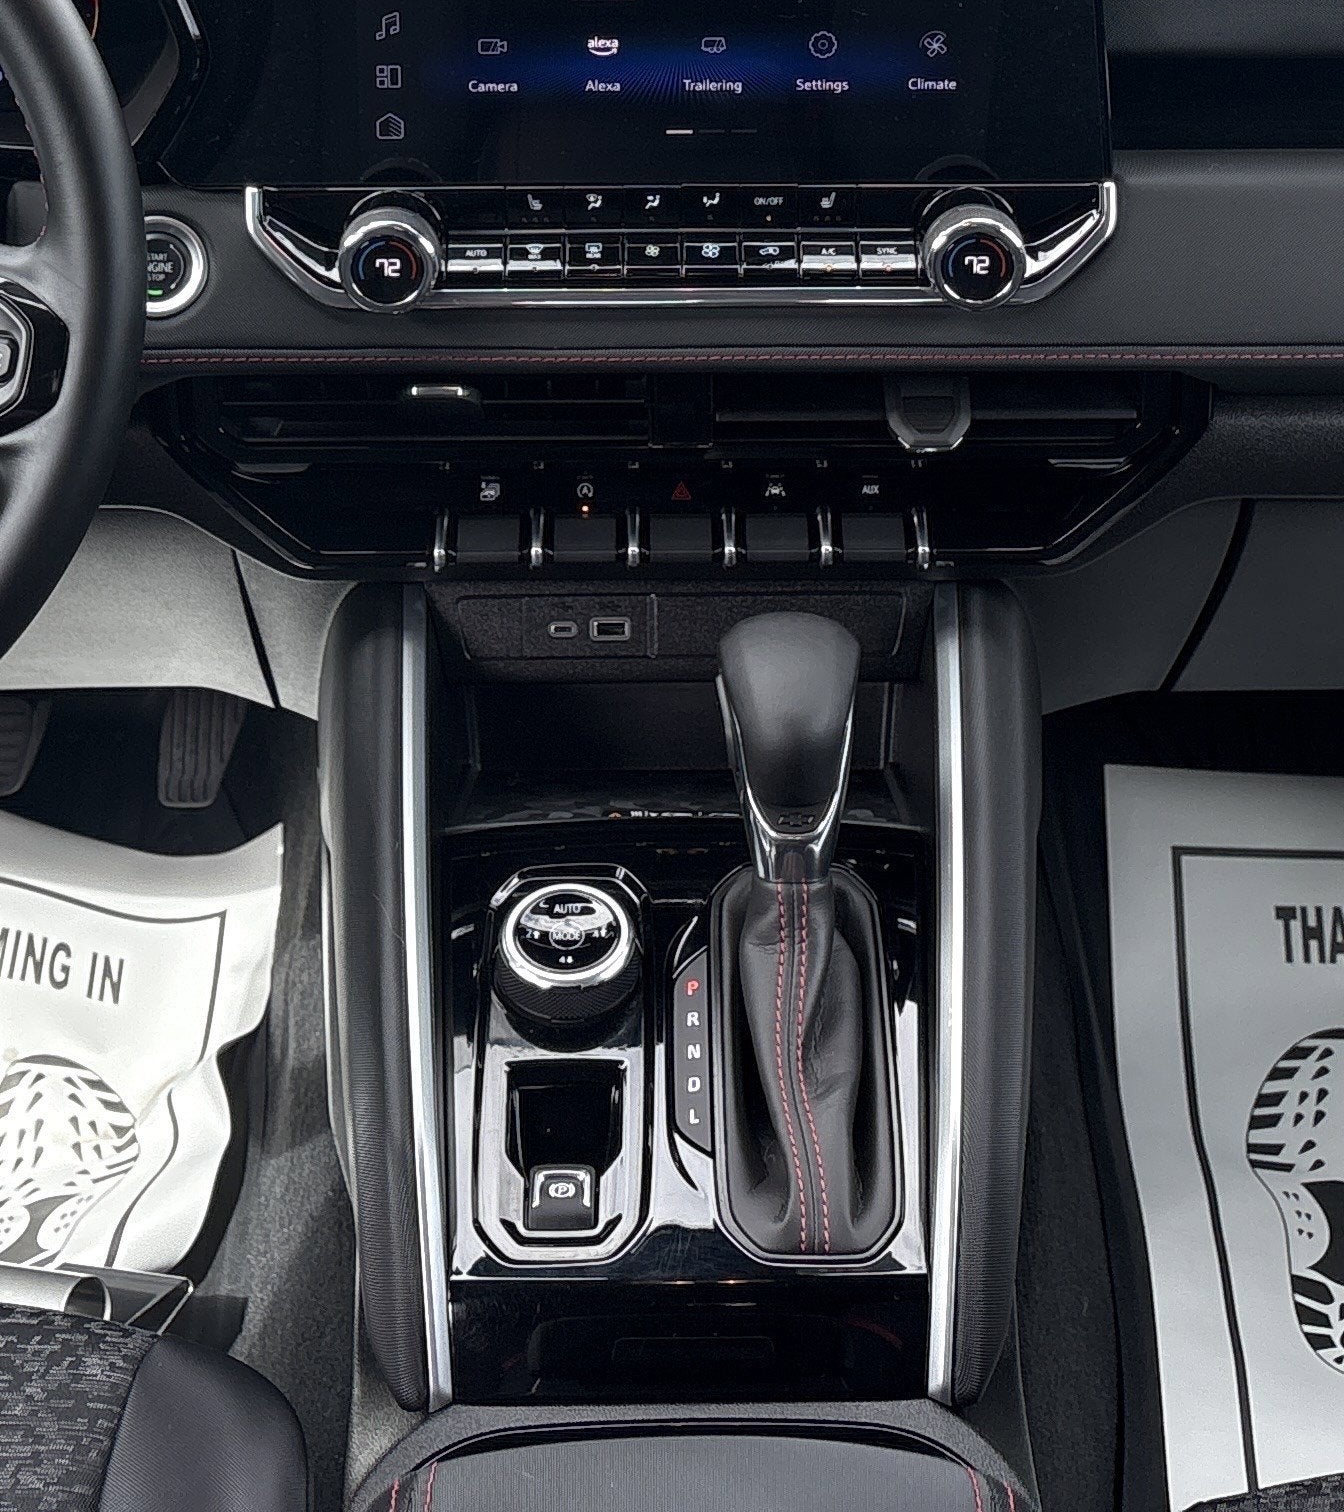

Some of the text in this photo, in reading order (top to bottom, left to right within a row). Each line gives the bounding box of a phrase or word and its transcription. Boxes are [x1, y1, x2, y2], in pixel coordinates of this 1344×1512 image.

[588, 35, 618, 49] alexa
[468, 80, 518, 93] Camera
[585, 80, 620, 92] Alexa
[683, 78, 742, 94] Trailering
[796, 78, 848, 94] Settings
[908, 77, 957, 91] Climate
[754, 197, 783, 206] ON/OFF
[465, 249, 487, 257] AUTO
[877, 247, 897, 255] SYNC
[375, 257, 401, 276] 72
[964, 256, 989, 275] 72
[553, 904, 581, 914] AUTO
[86, 951, 126, 1005] IN
[688, 980, 699, 996] P
[687, 1011, 700, 1026] R
[687, 1045, 700, 1059] N
[687, 1077, 700, 1092] D
[688, 1109, 700, 1124] L
